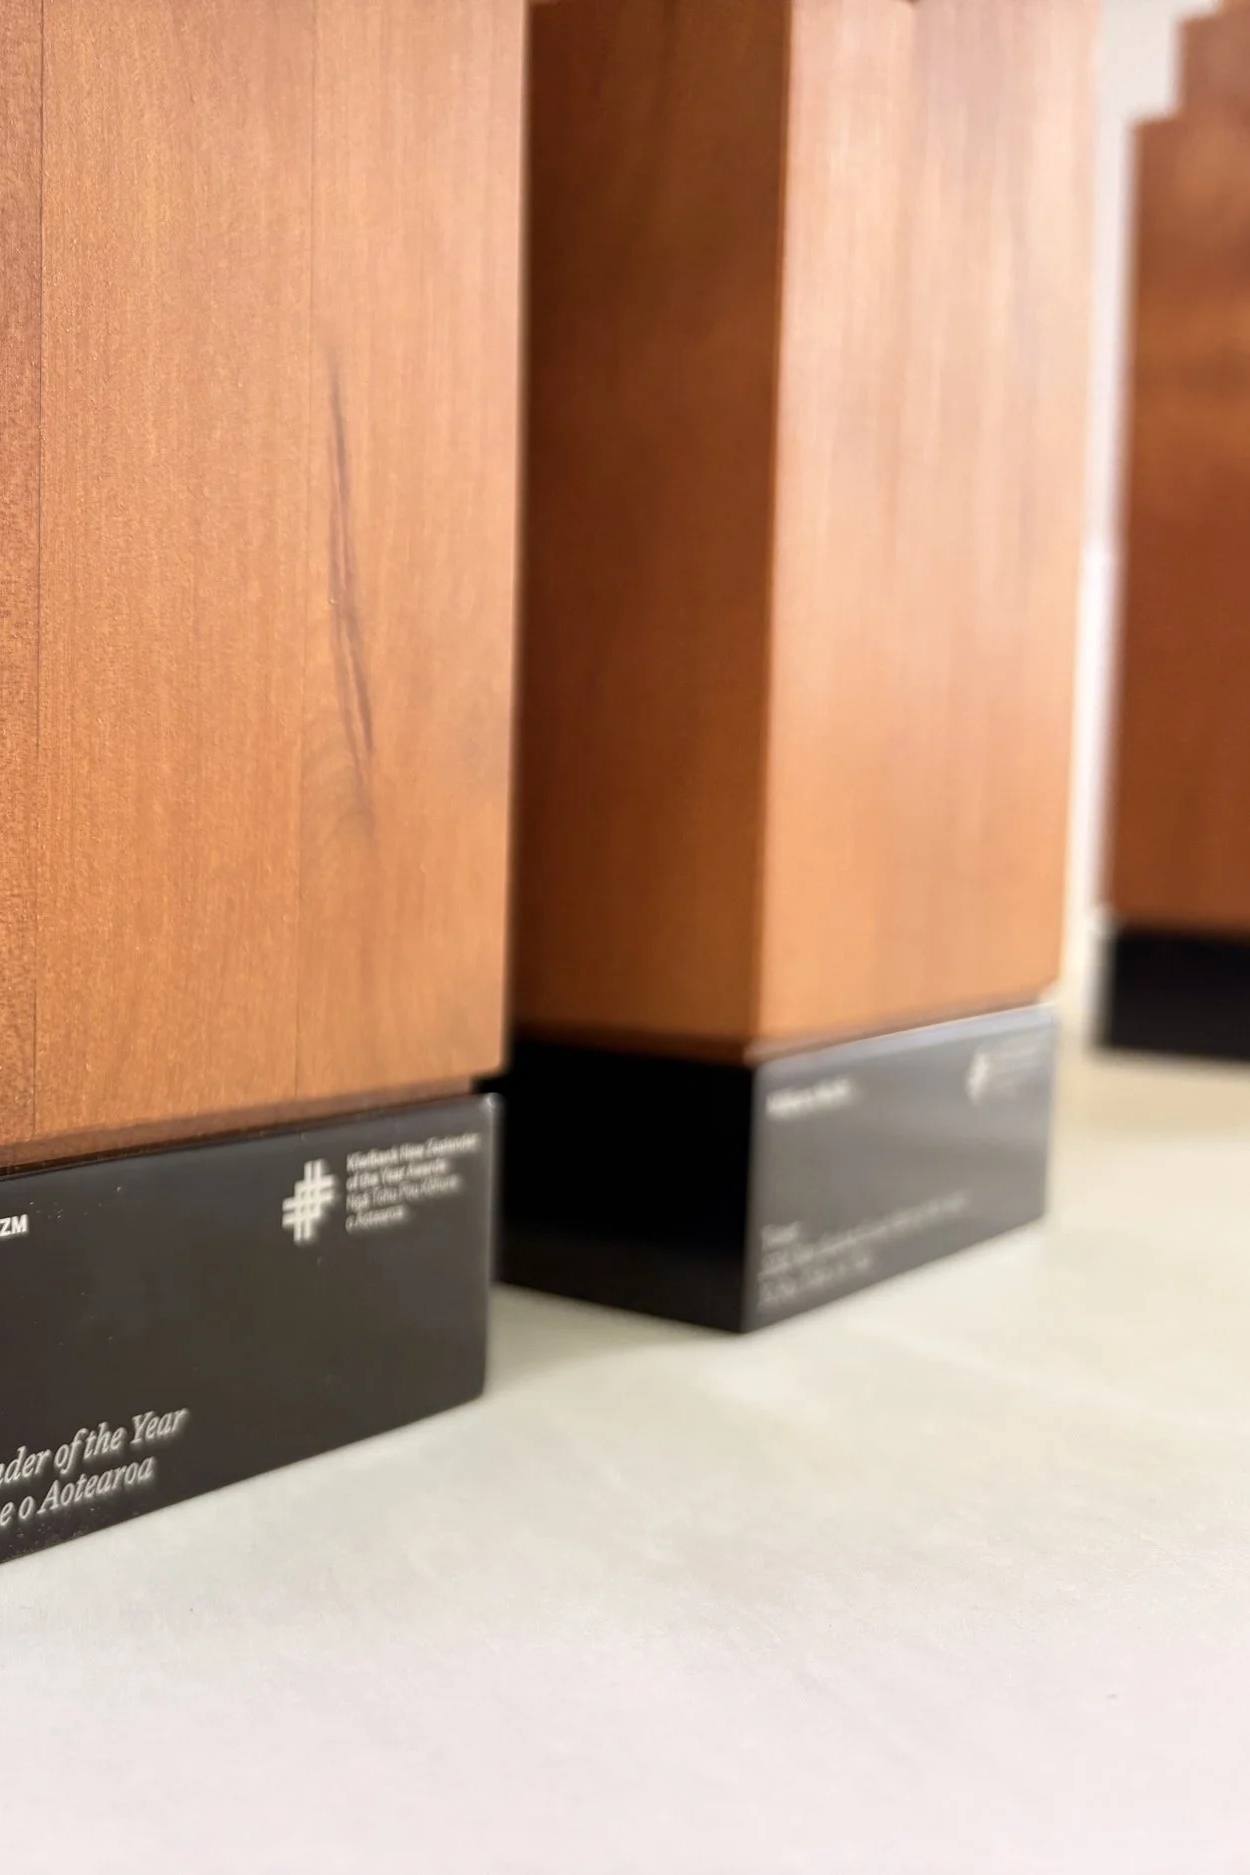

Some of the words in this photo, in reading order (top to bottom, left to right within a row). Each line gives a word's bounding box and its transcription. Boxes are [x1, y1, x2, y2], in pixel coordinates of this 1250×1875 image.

[346, 1171, 358, 1191] of
[359, 1169, 380, 1188] the
[381, 1166, 406, 1184] Year
[406, 1158, 447, 1178] Awards
[347, 1149, 398, 1172] Kiwibank
[400, 1143, 424, 1161] New
[425, 1133, 479, 1157] Zealander
[54, 1428, 86, 1481] of
[84, 1421, 125, 1456] the
[132, 1407, 187, 1445] Year
[17, 1496, 34, 1520] o
[37, 1456, 156, 1513] Aotearoa
